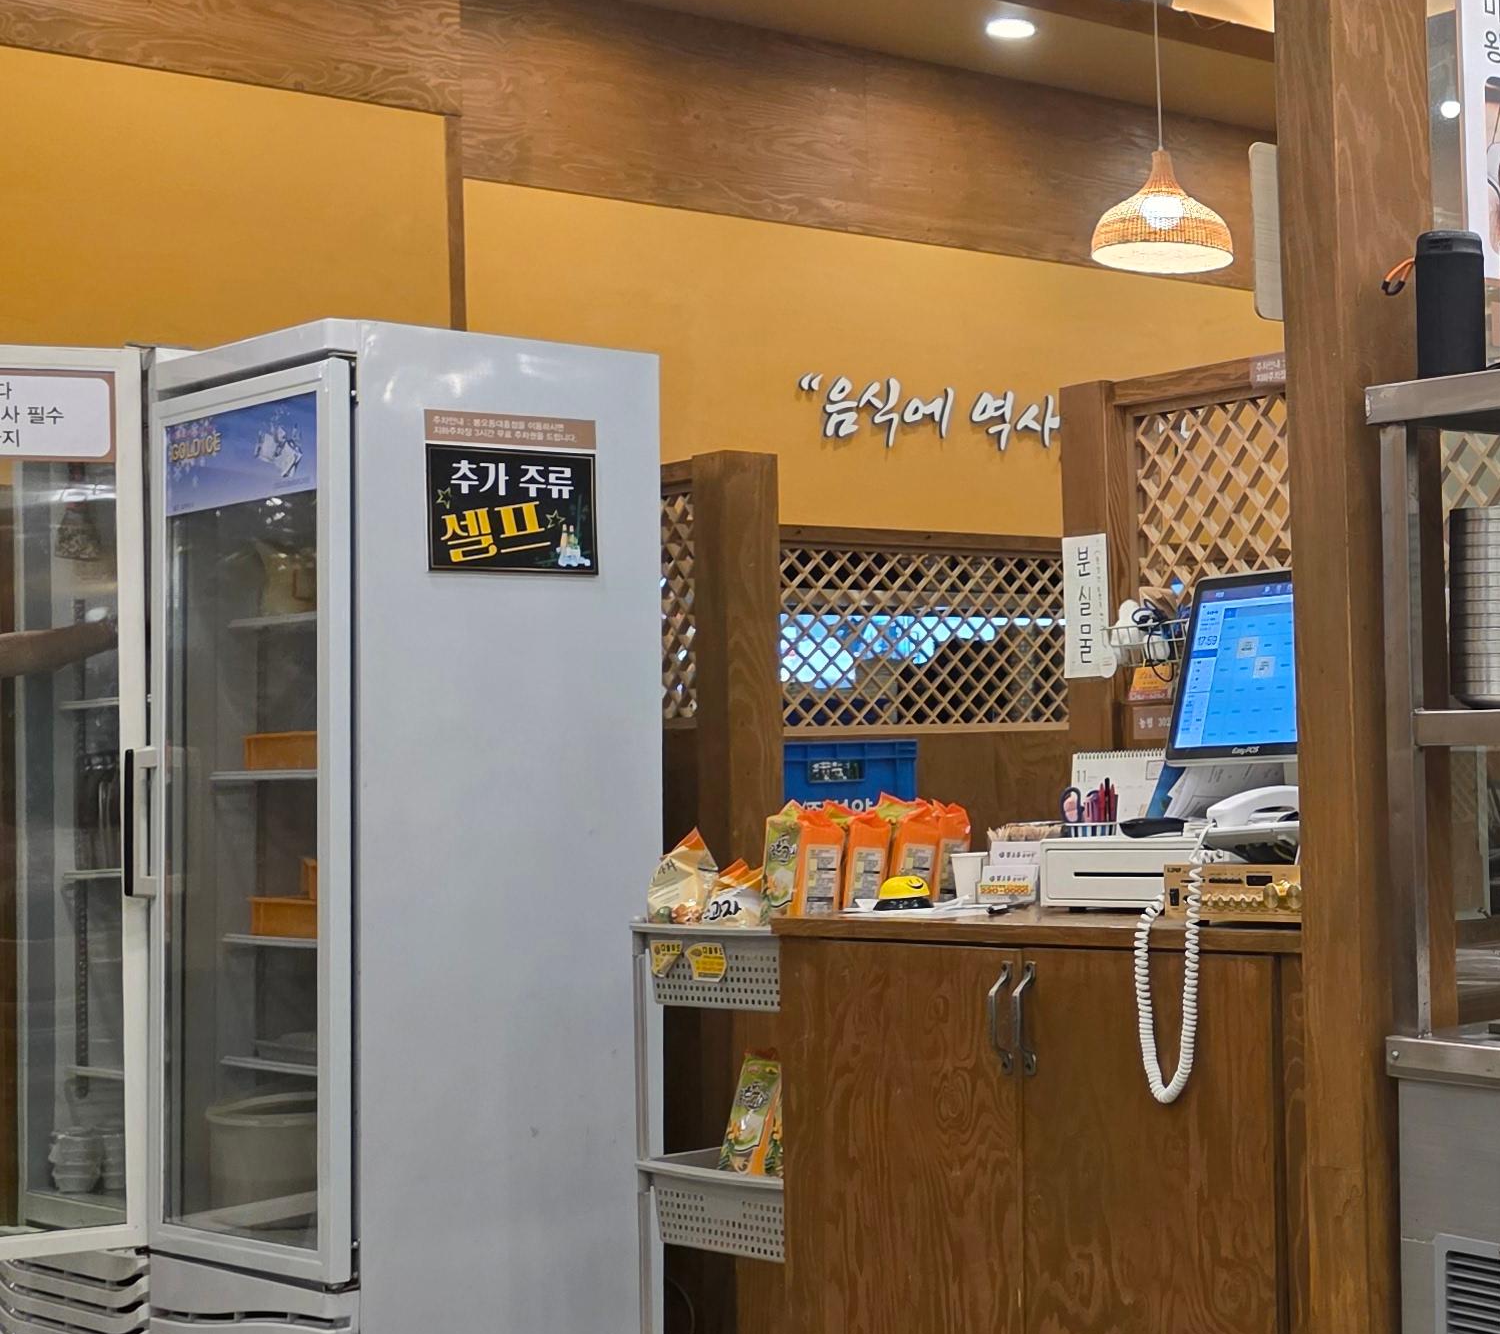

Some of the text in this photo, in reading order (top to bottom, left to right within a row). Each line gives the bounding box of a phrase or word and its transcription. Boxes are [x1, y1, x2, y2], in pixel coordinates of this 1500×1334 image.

[1, 405, 65, 425] 사 필수
[798, 372, 1061, 452] “음식에 역사
[0, 428, 20, 448] 지
[450, 459, 575, 500] 추가 주류
[440, 500, 552, 563] 셀프
